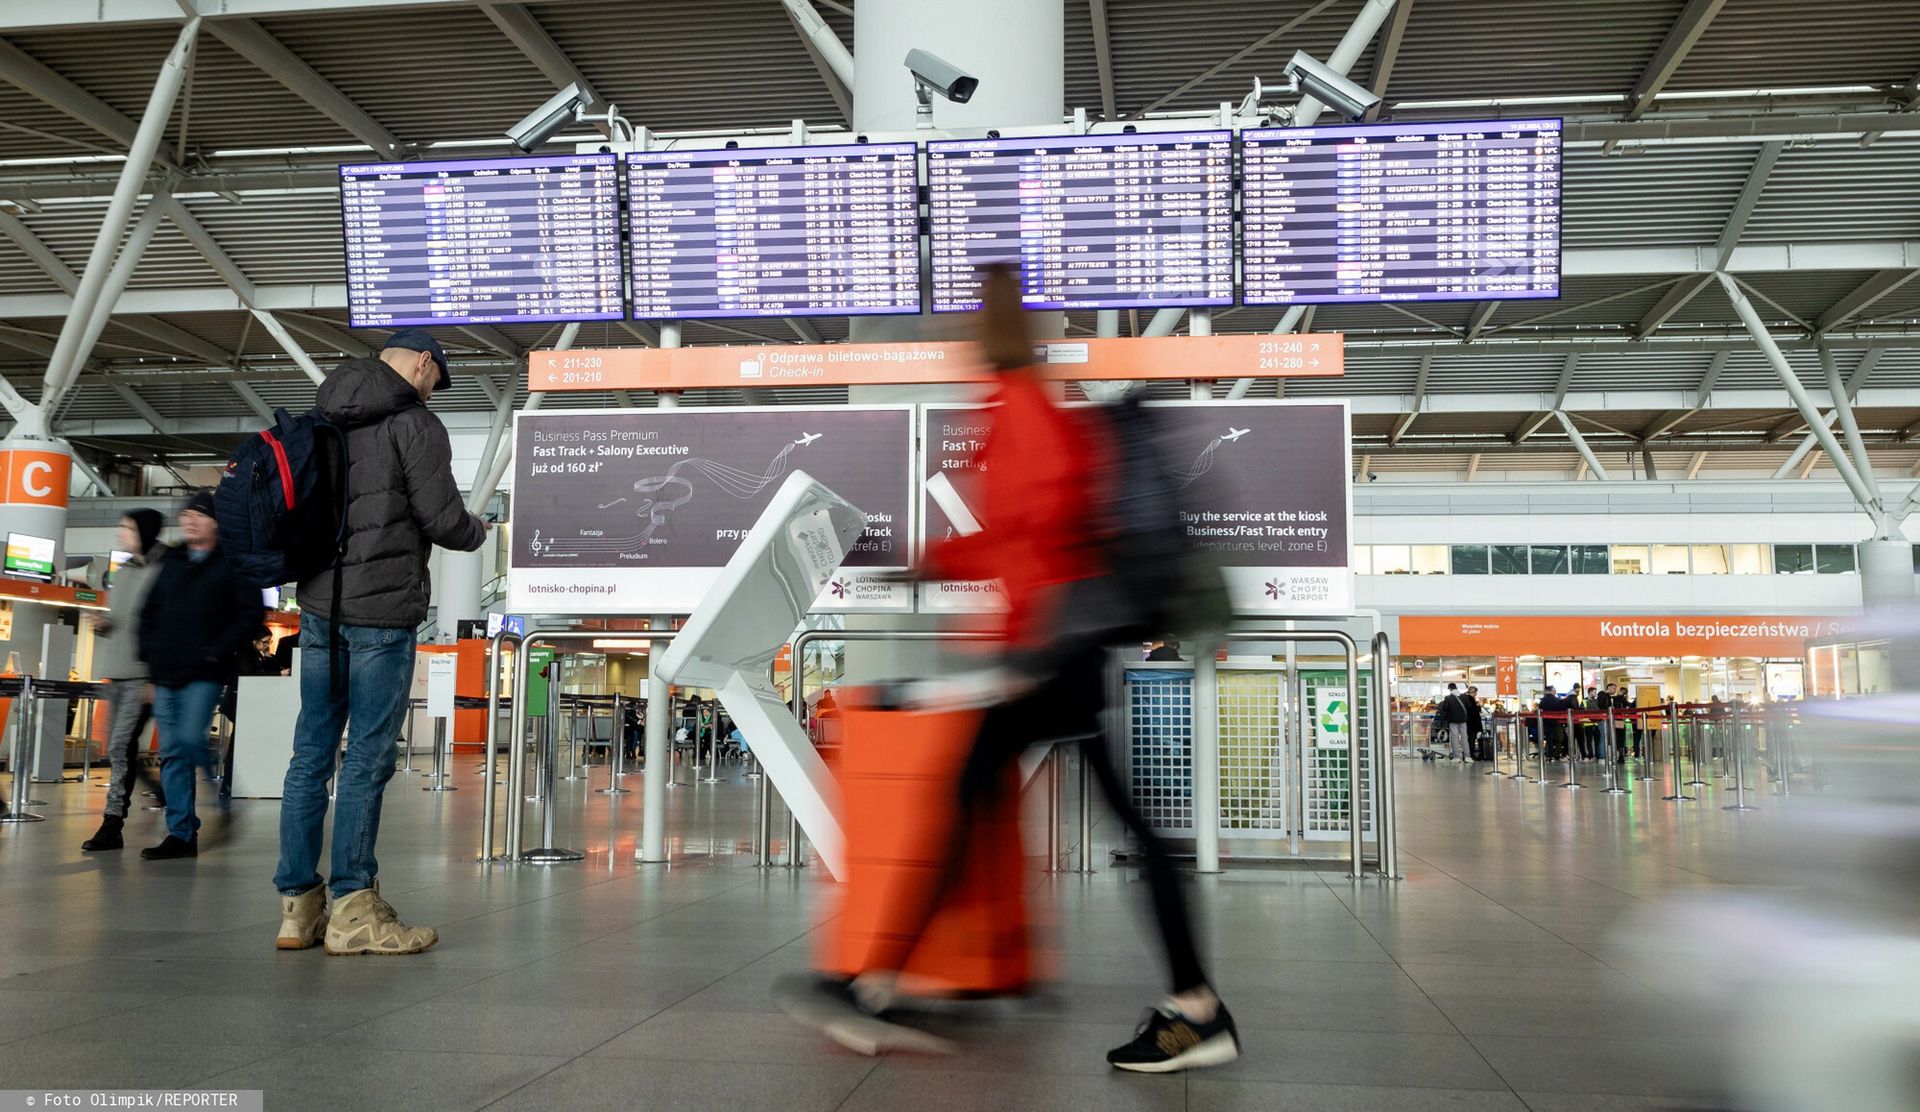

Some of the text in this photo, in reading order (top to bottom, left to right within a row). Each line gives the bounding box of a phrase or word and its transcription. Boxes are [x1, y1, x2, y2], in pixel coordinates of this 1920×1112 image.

[1259, 343, 1302, 354] 231-240
[770, 350, 944, 364] Odprawa biletowo-bagażowa
[564, 358, 602, 368] 211-230
[1260, 358, 1303, 368] 241-280
[563, 372, 602, 382] 201-210
[770, 367, 824, 377] Check-in
[943, 424, 991, 436] Business
[534, 430, 658, 442] Business Pass Premium
[533, 446, 555, 456] Fast
[558, 446, 586, 456] Track
[597, 445, 634, 458] Salony
[636, 444, 688, 455] Executive
[943, 440, 986, 451] Fast Tra
[532, 462, 548, 476] już
[551, 462, 564, 473] od
[567, 463, 586, 472] 160
[22, 461, 52, 497] C
[865, 513, 891, 523] osku
[1180, 511, 1327, 524] Buy the service at the kiosk
[717, 528, 739, 539] przy
[865, 527, 891, 536] Track
[1187, 526, 1328, 538] Business/Fast Track entry
[882, 541, 892, 552] E)
[1288, 542, 1314, 551] zone
[1317, 541, 1327, 552] E)
[529, 584, 616, 595] lotnisko-chopina.pl
[1601, 621, 1670, 637] Kontrola
[1676, 620, 1808, 640] bezpieczeństwa
